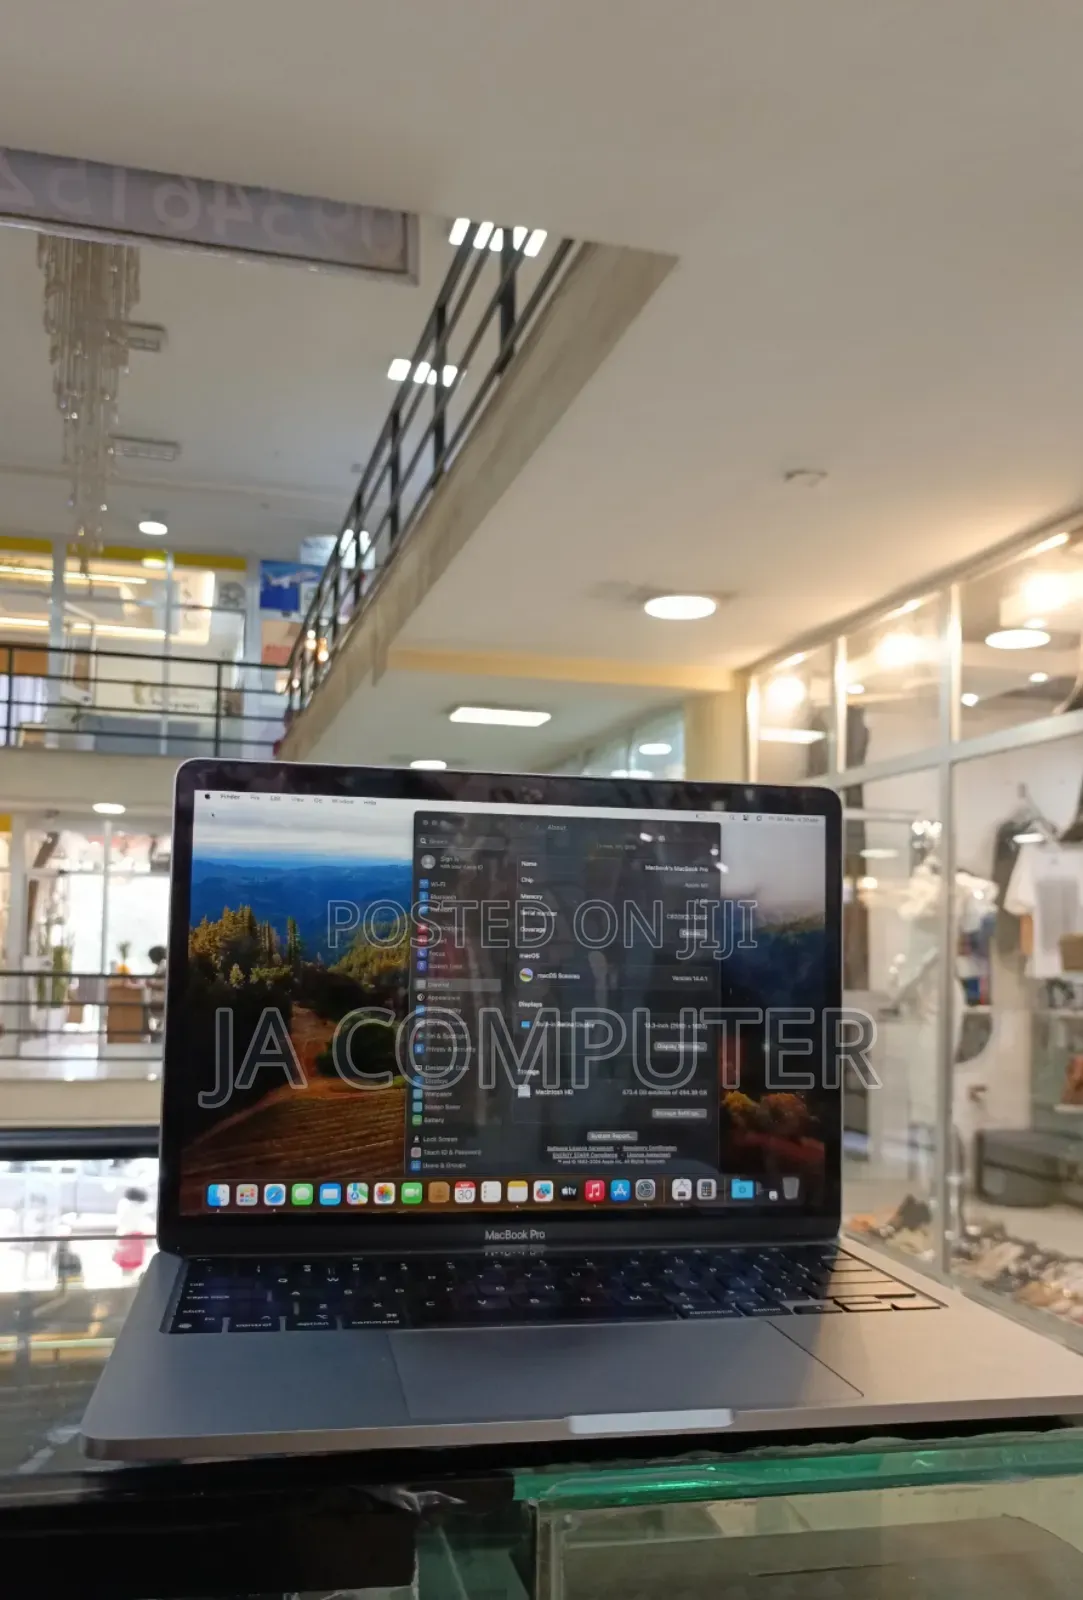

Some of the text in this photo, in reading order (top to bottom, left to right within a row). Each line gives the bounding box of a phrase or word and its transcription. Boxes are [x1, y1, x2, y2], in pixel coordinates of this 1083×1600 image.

[457, 1189, 473, 1201] 30
[484, 1229, 546, 1240] MacBook Pro
